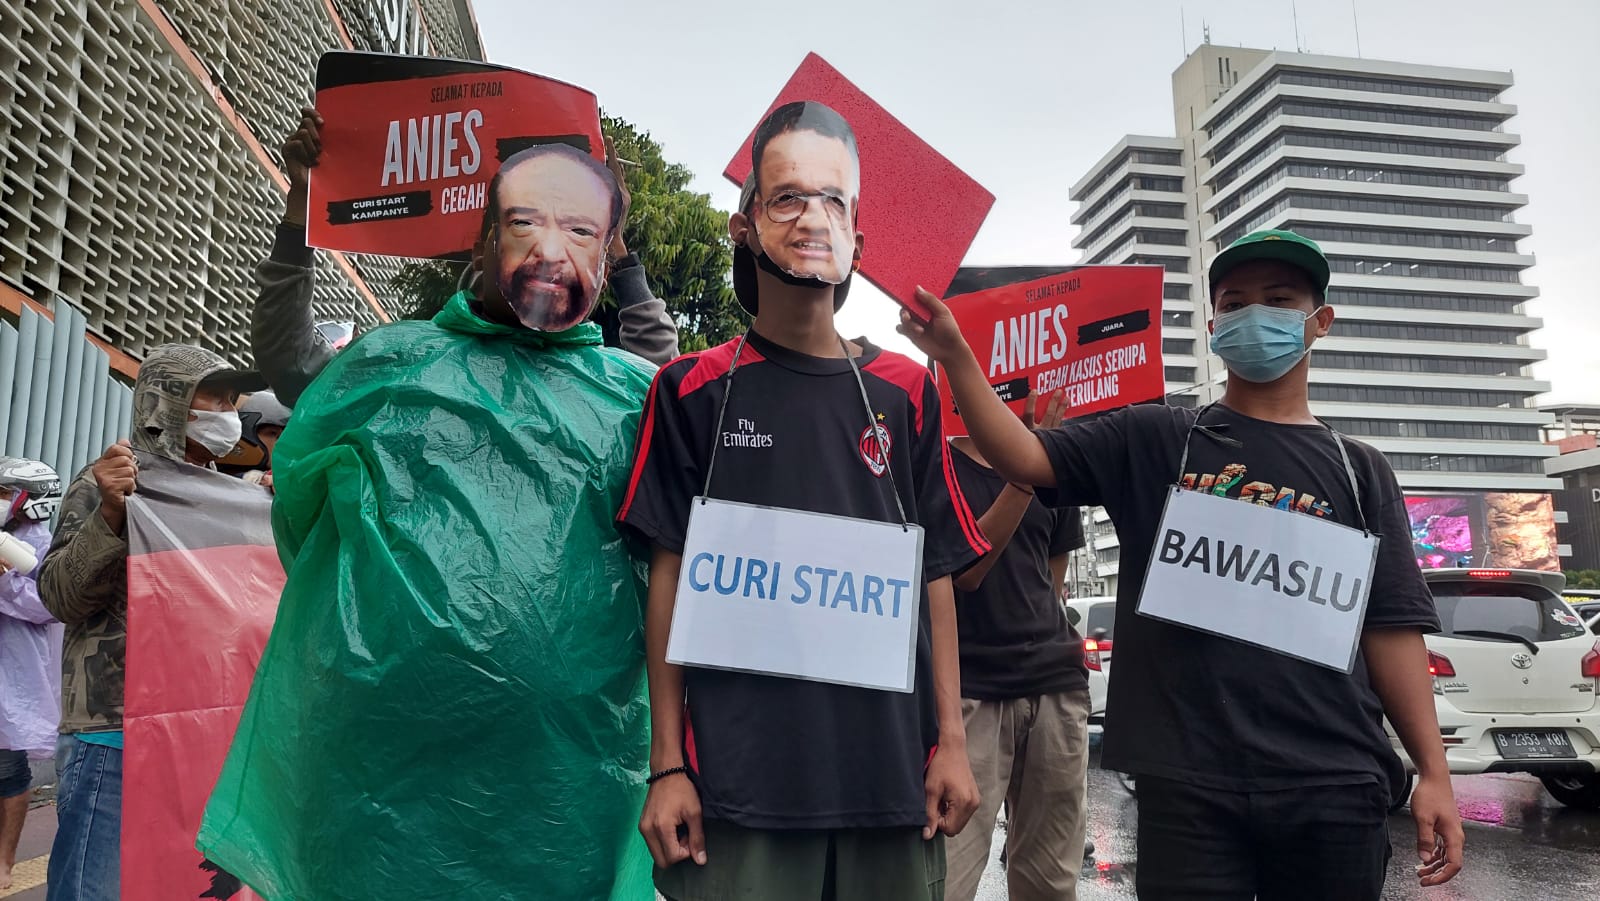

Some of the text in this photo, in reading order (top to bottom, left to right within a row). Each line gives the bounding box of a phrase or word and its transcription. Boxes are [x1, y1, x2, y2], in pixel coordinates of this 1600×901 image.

[431, 81, 503, 103] SELAMAT KEPADA
[381, 109, 483, 187] ANIES
[353, 196, 407, 209] CURI START
[441, 182, 486, 214] CEGAH
[352, 207, 409, 220] KAMPANYE
[1025, 277, 1081, 302] SELAMAT KEPADA
[1101, 321, 1124, 333] JUARA
[989, 304, 1069, 377] ANIES
[1037, 342, 1146, 396] CEGAH KASUS SERUPA
[1065, 374, 1119, 408] TERULANG
[738, 418, 755, 433] Fly
[722, 431, 773, 448] Emirates
[1158, 529, 1362, 612] BAWASLU
[688, 552, 910, 618] CURI START
[1511, 733, 1540, 746] 2353
